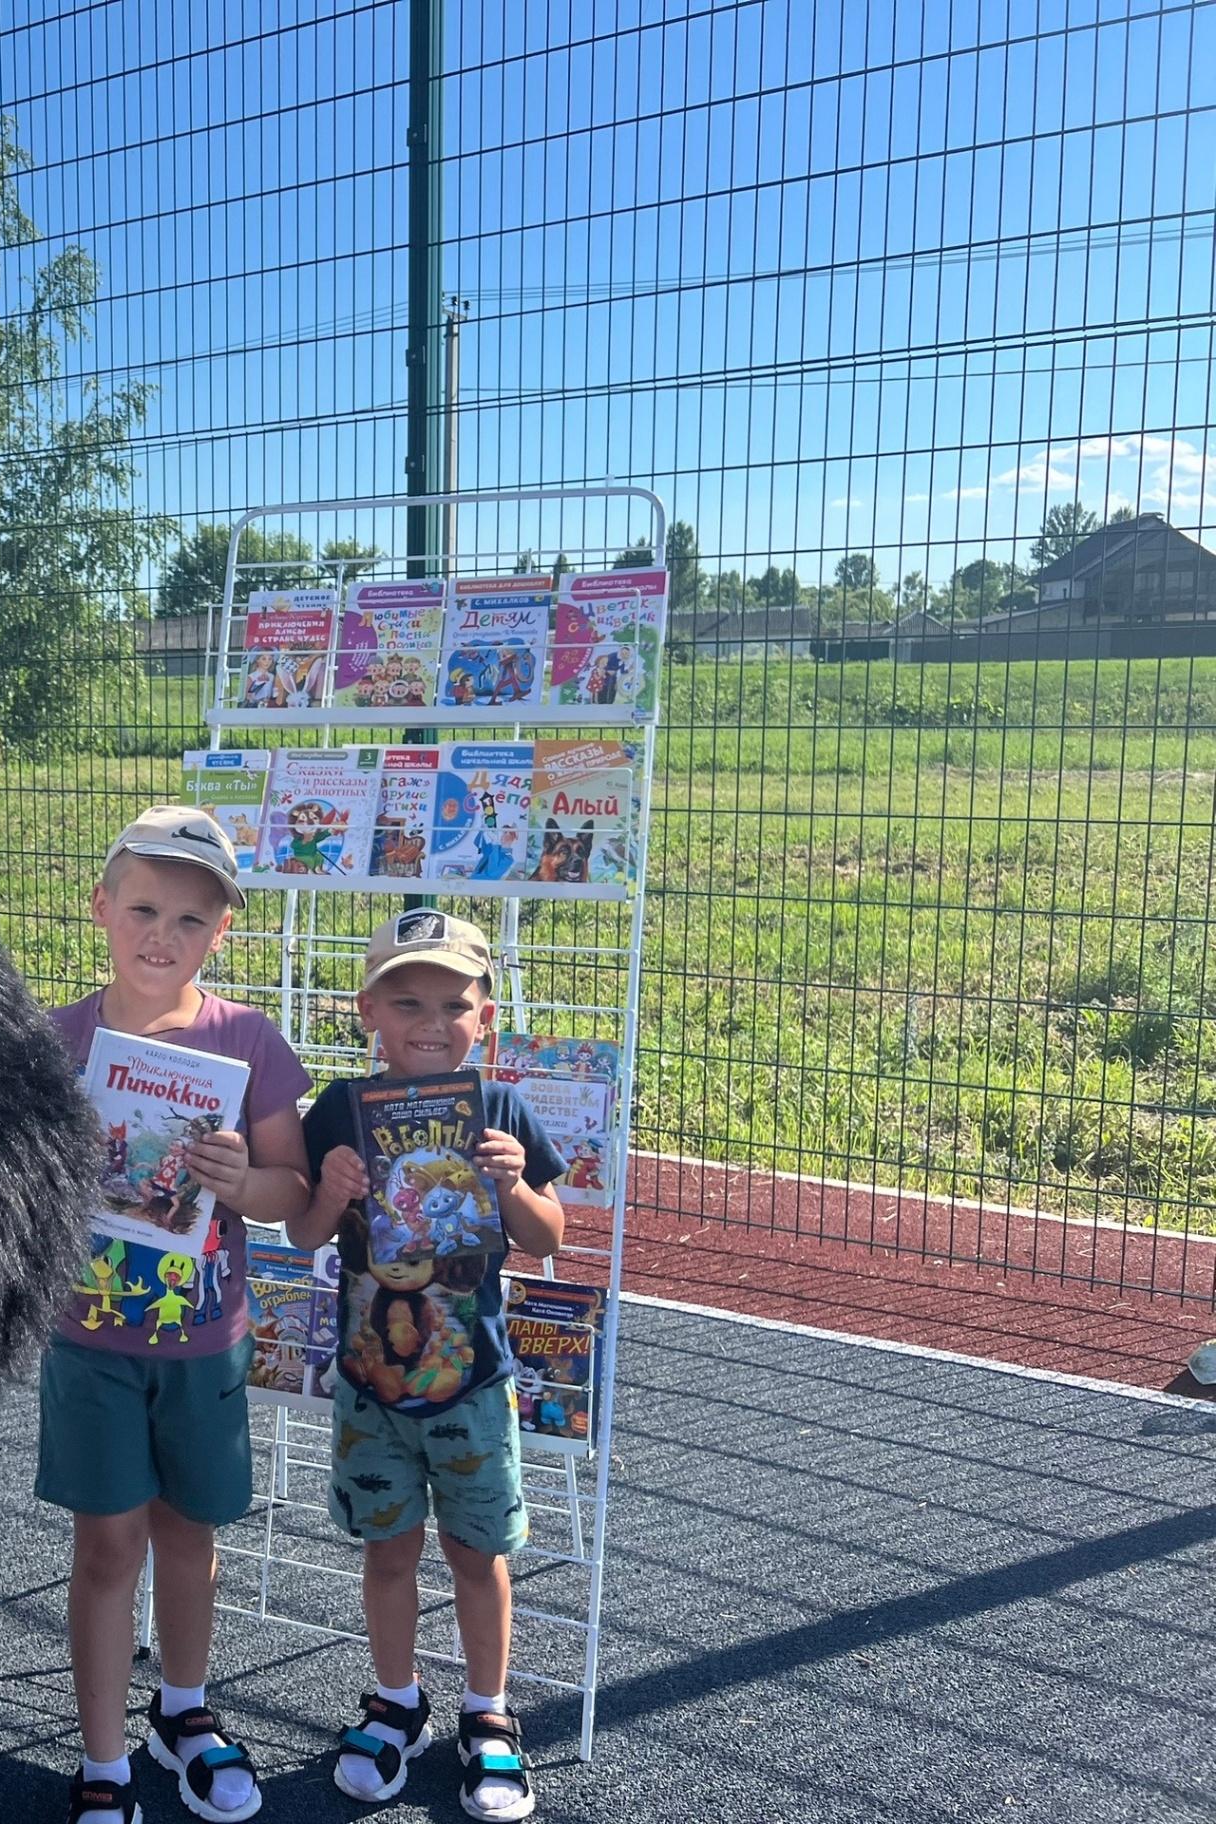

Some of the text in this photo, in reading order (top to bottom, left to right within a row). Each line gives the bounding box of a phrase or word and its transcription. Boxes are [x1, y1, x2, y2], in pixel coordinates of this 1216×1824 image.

[484, 597, 529, 605] МИХАЛКОВ
[258, 621, 325, 629] ПРИКЛЮЧЕНИЯ
[459, 610, 536, 630] Детям
[262, 635, 295, 643] СТРАНЕ
[297, 634, 326, 642] ЧУДЕС
[364, 752, 372, 761] 3
[544, 746, 604, 770] РАССКАЗЫ
[286, 761, 344, 776] Сказки
[225, 780, 258, 791] «Ты»
[312, 777, 368, 788] рассказы
[468, 771, 533, 791] Дядя
[304, 788, 367, 796] животных
[464, 790, 531, 814] Сёпа
[552, 791, 619, 815] Алый
[128, 1055, 213, 1088] Приключения
[107, 1063, 221, 1112] Пиноккио
[508, 1320, 560, 1335] ЛАПЫ
[519, 1335, 590, 1354] ВВЕРХ!
